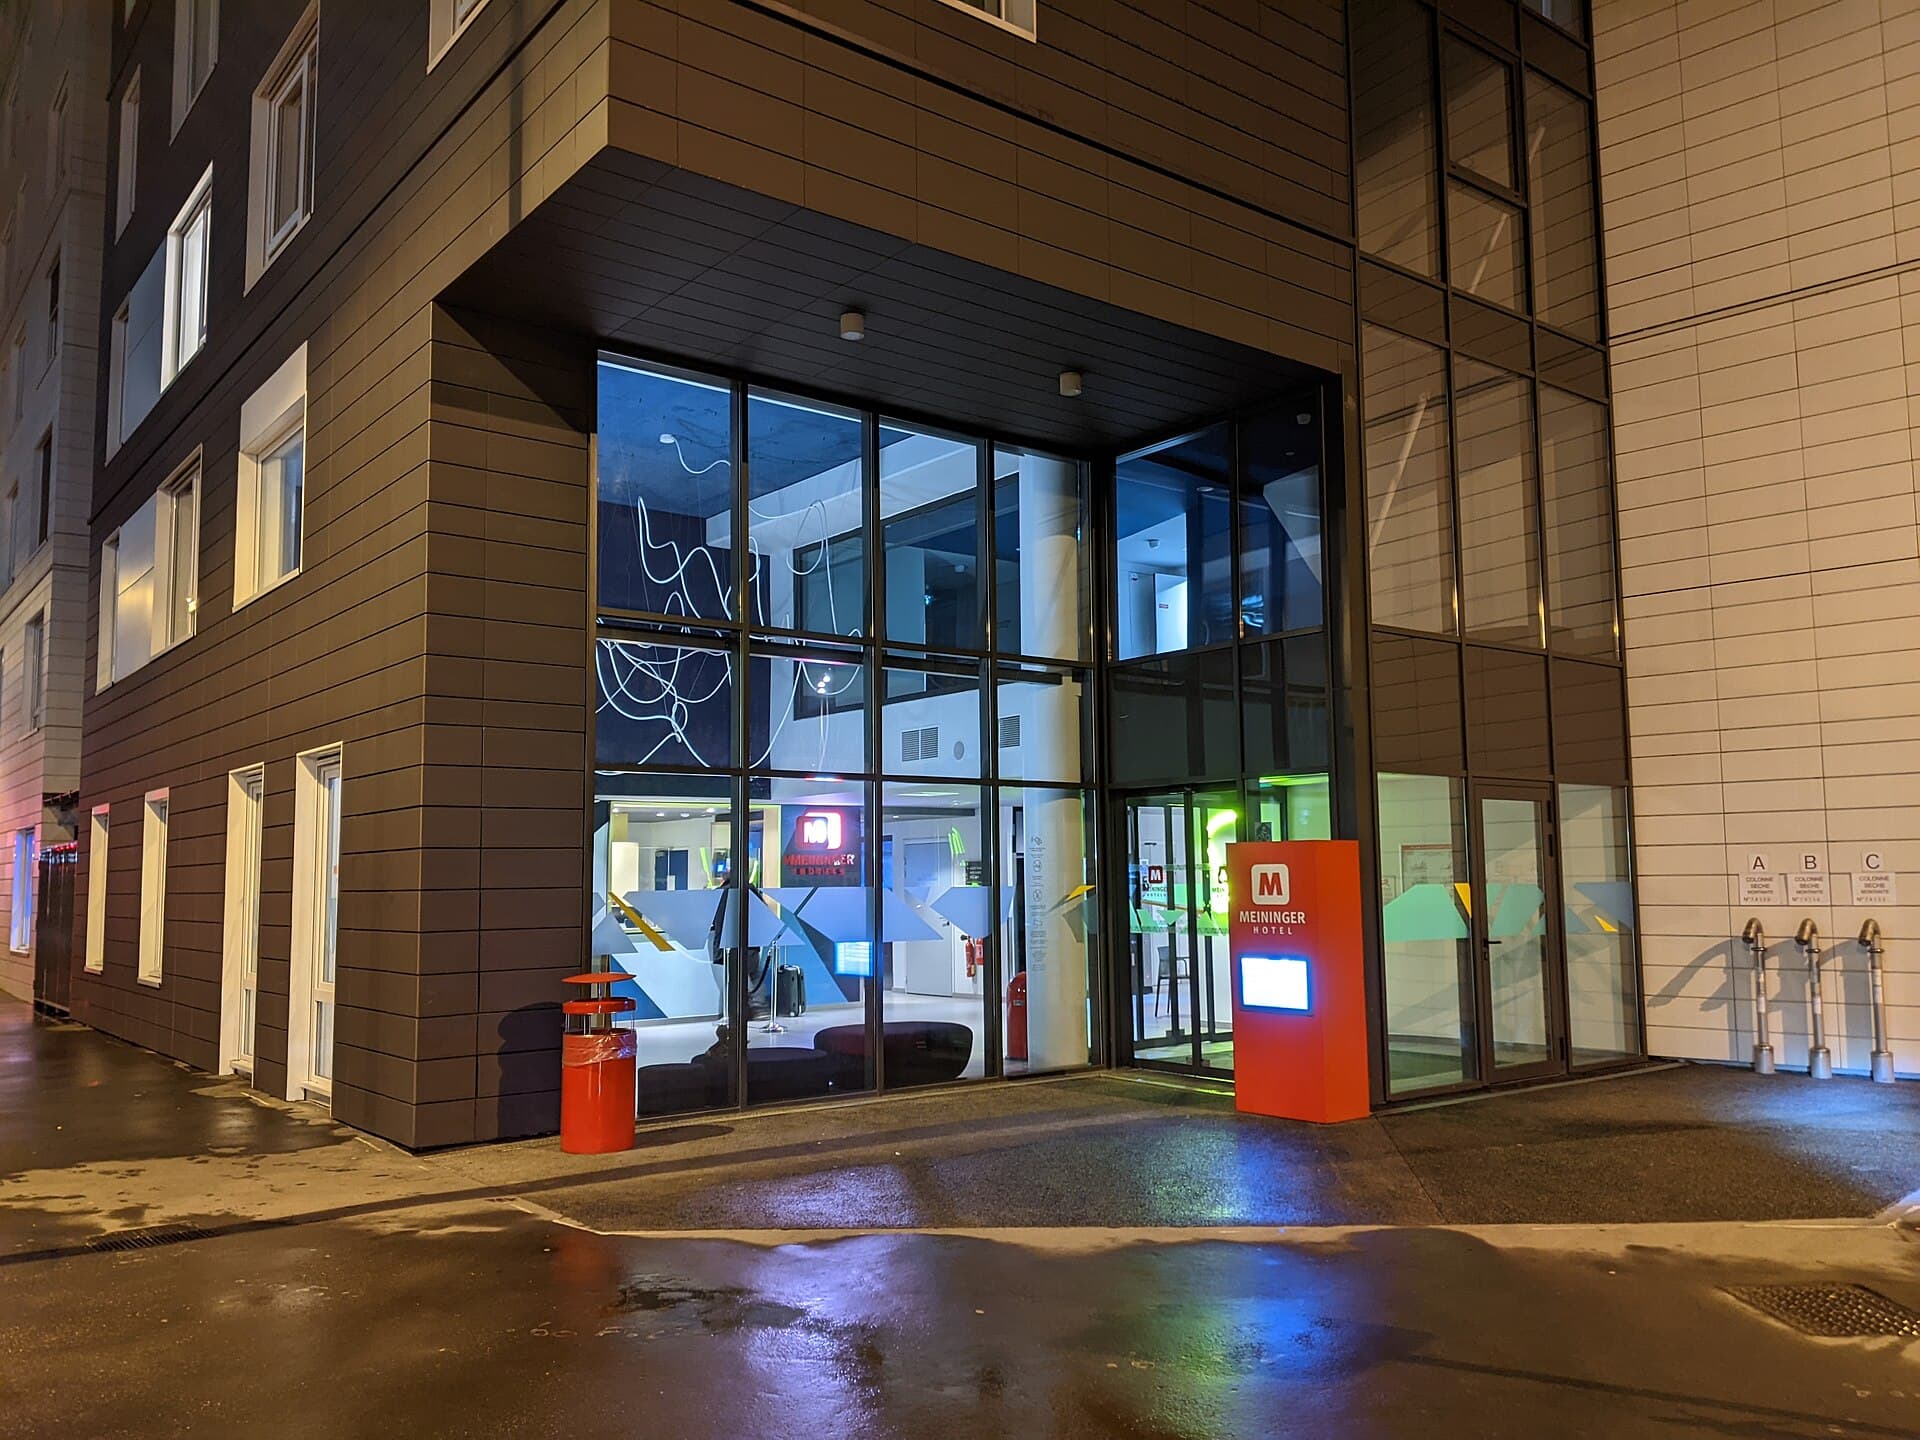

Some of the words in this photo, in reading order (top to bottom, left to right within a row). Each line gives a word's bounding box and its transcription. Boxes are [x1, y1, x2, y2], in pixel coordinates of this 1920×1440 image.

[1752, 855, 1765, 870] A
[1804, 855, 1817, 870] B
[1865, 853, 1880, 870] C
[1150, 869, 1161, 881] M
[1259, 872, 1283, 896] M
[1239, 910, 1306, 924] MEININGER
[1253, 926, 1293, 935] HOTEL
